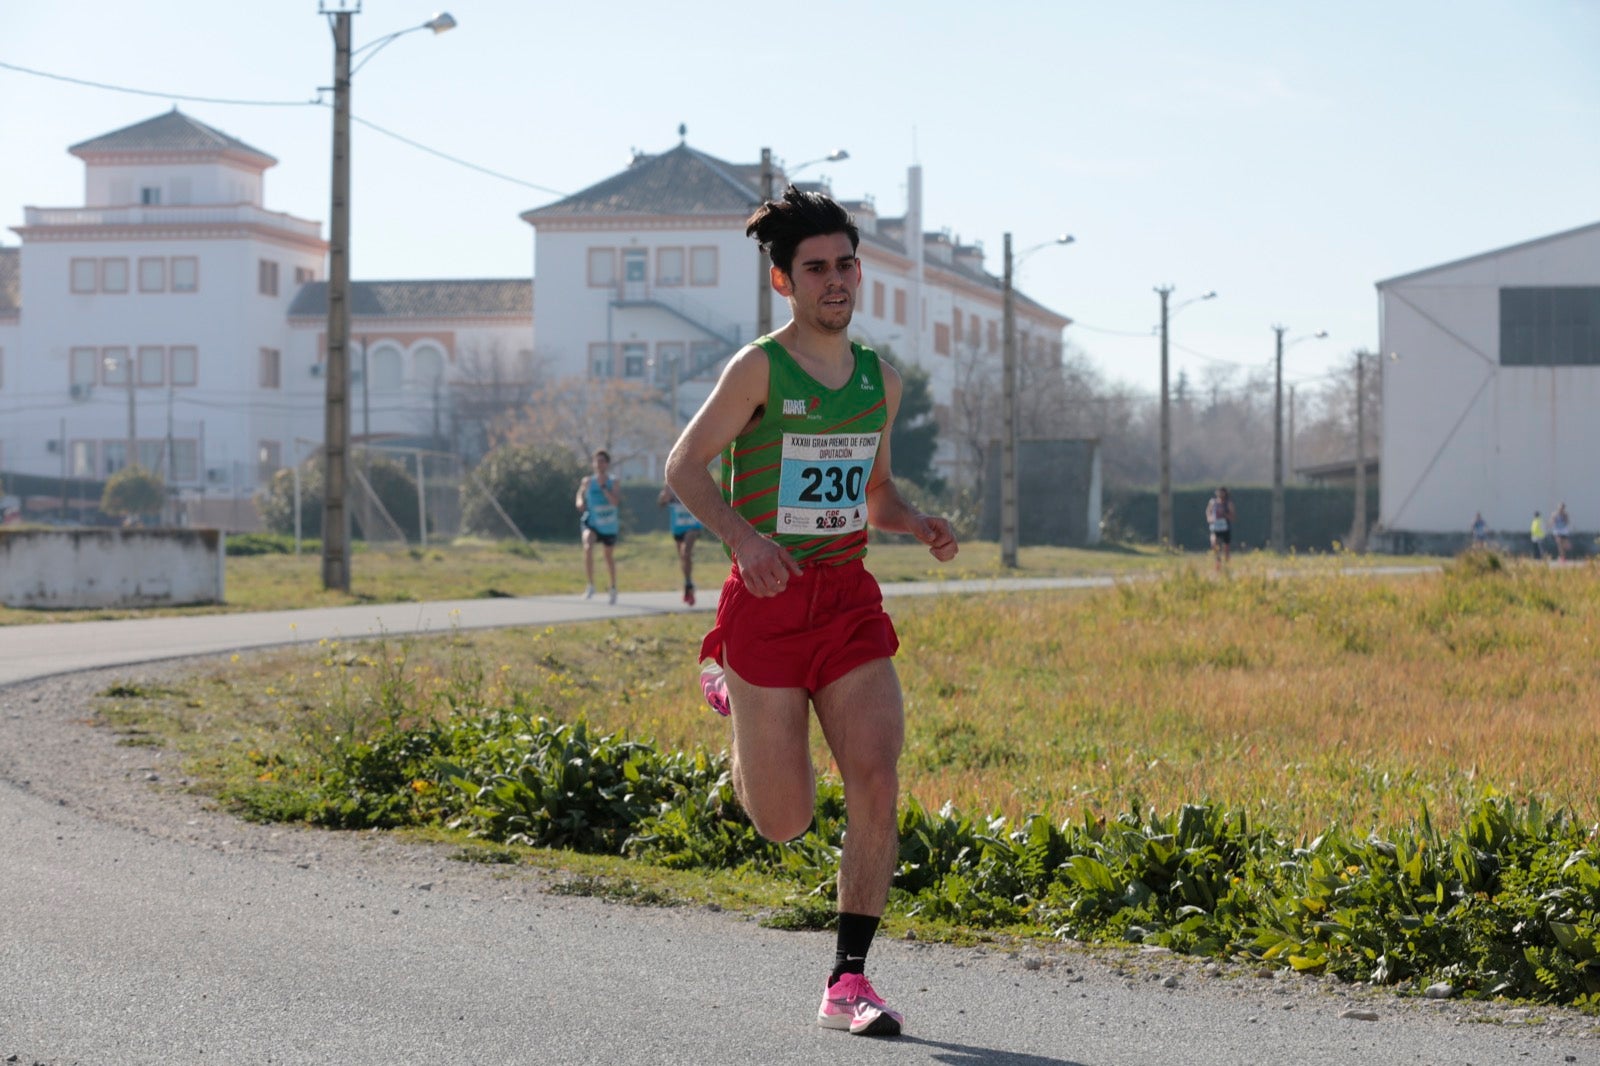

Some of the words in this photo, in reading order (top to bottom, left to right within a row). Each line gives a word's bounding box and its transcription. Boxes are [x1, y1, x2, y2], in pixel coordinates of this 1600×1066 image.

[812, 438, 827, 448] GRAN
[828, 437, 849, 447] PREMIO
[850, 437, 858, 447] DE
[859, 436, 876, 446] FONDO
[819, 448, 852, 459] DIPUTACIÓN
[798, 466, 863, 502] 230
